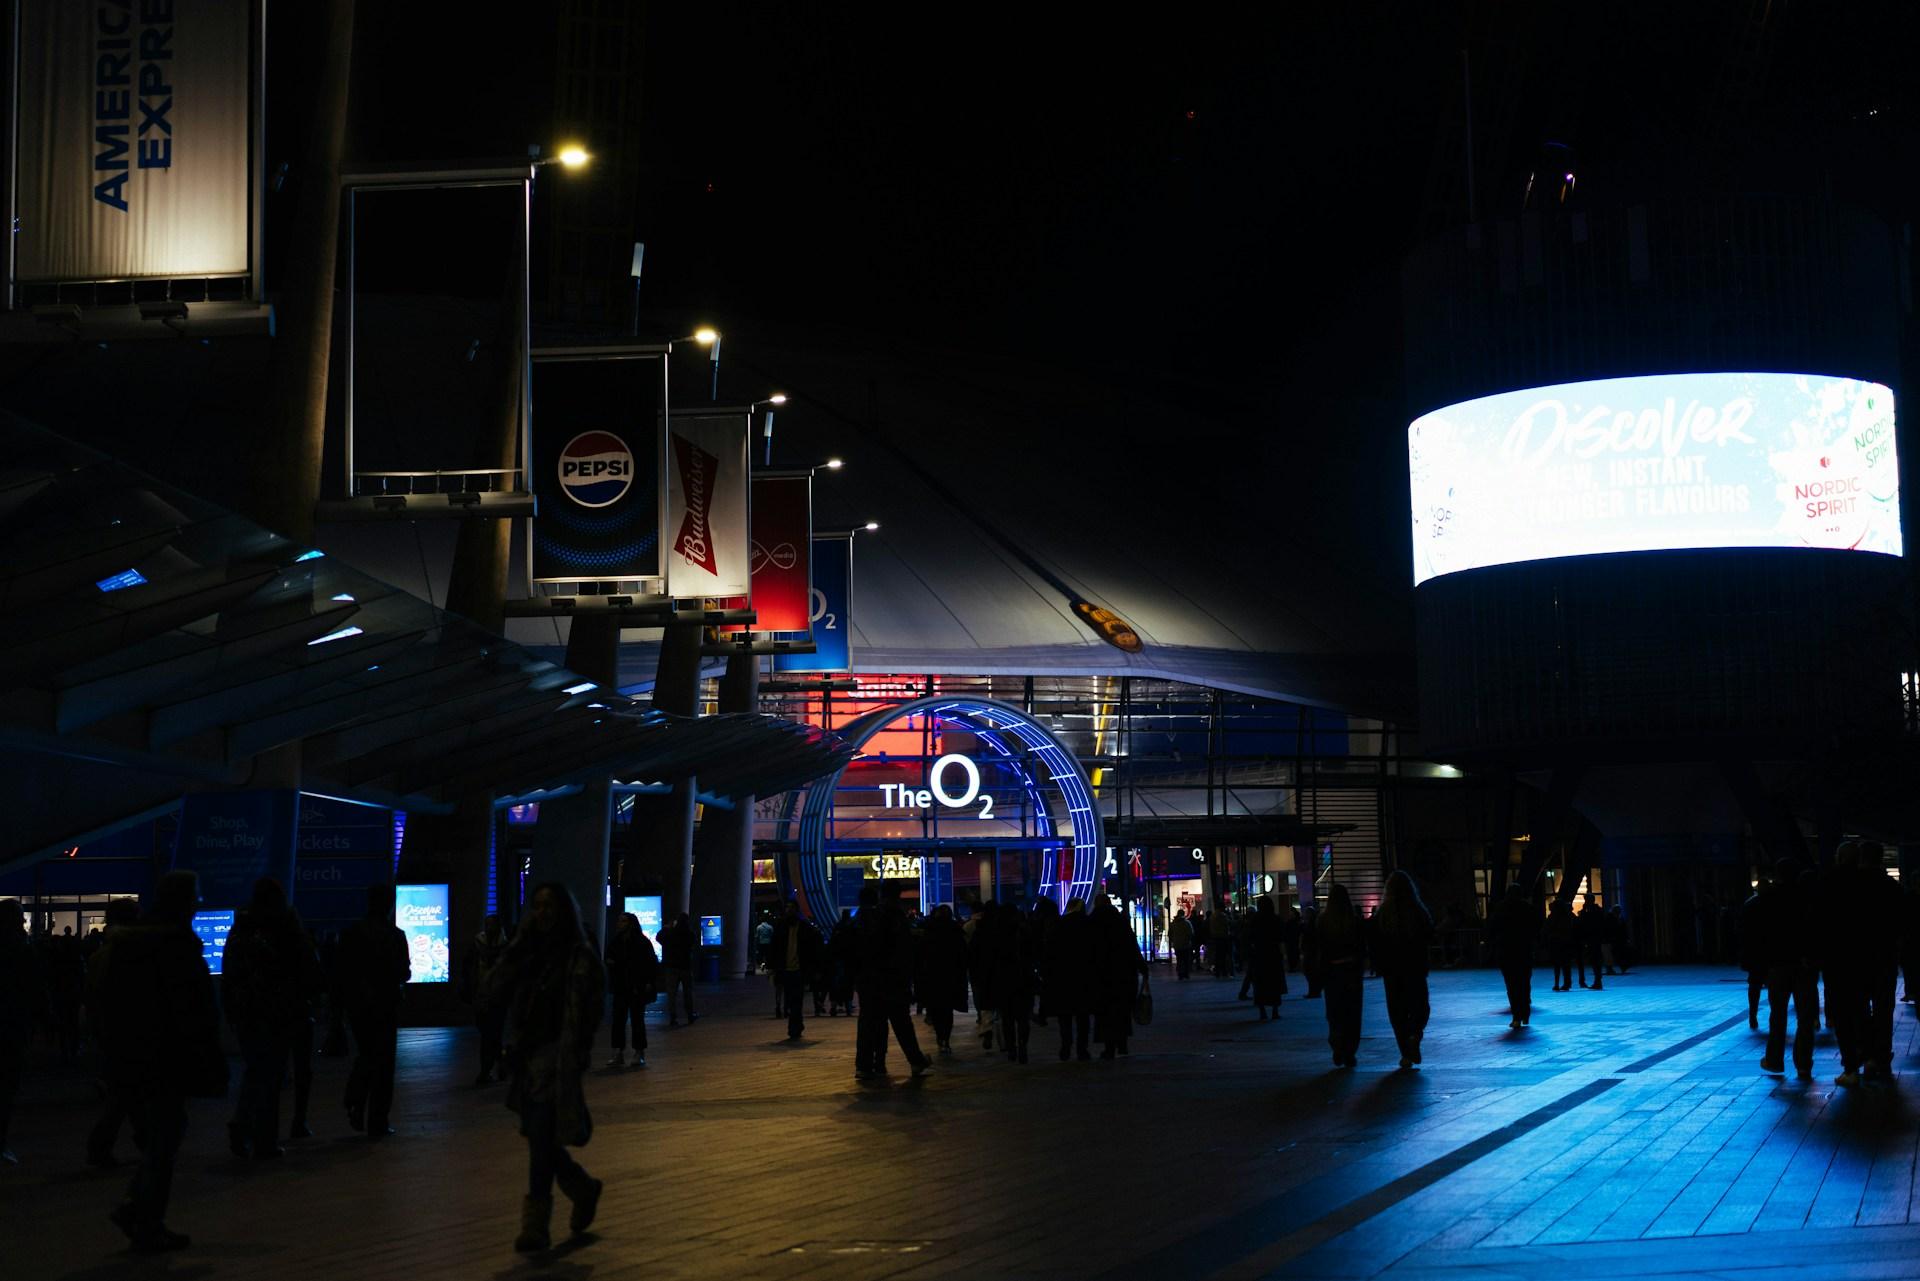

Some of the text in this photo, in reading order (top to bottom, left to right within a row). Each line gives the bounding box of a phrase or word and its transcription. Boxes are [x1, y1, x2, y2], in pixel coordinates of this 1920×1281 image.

[95, 0, 131, 213] AMERIC
[563, 460, 629, 477] PEPSI
[1635, 483, 1751, 517] FLAVOURS
[1795, 477, 1862, 501] NORDIC
[684, 447, 707, 566] Budweiser
[1806, 497, 1857, 519] SPIRIT
[879, 783, 932, 809] The
[232, 832, 265, 851] Play
[297, 832, 351, 850] ickets
